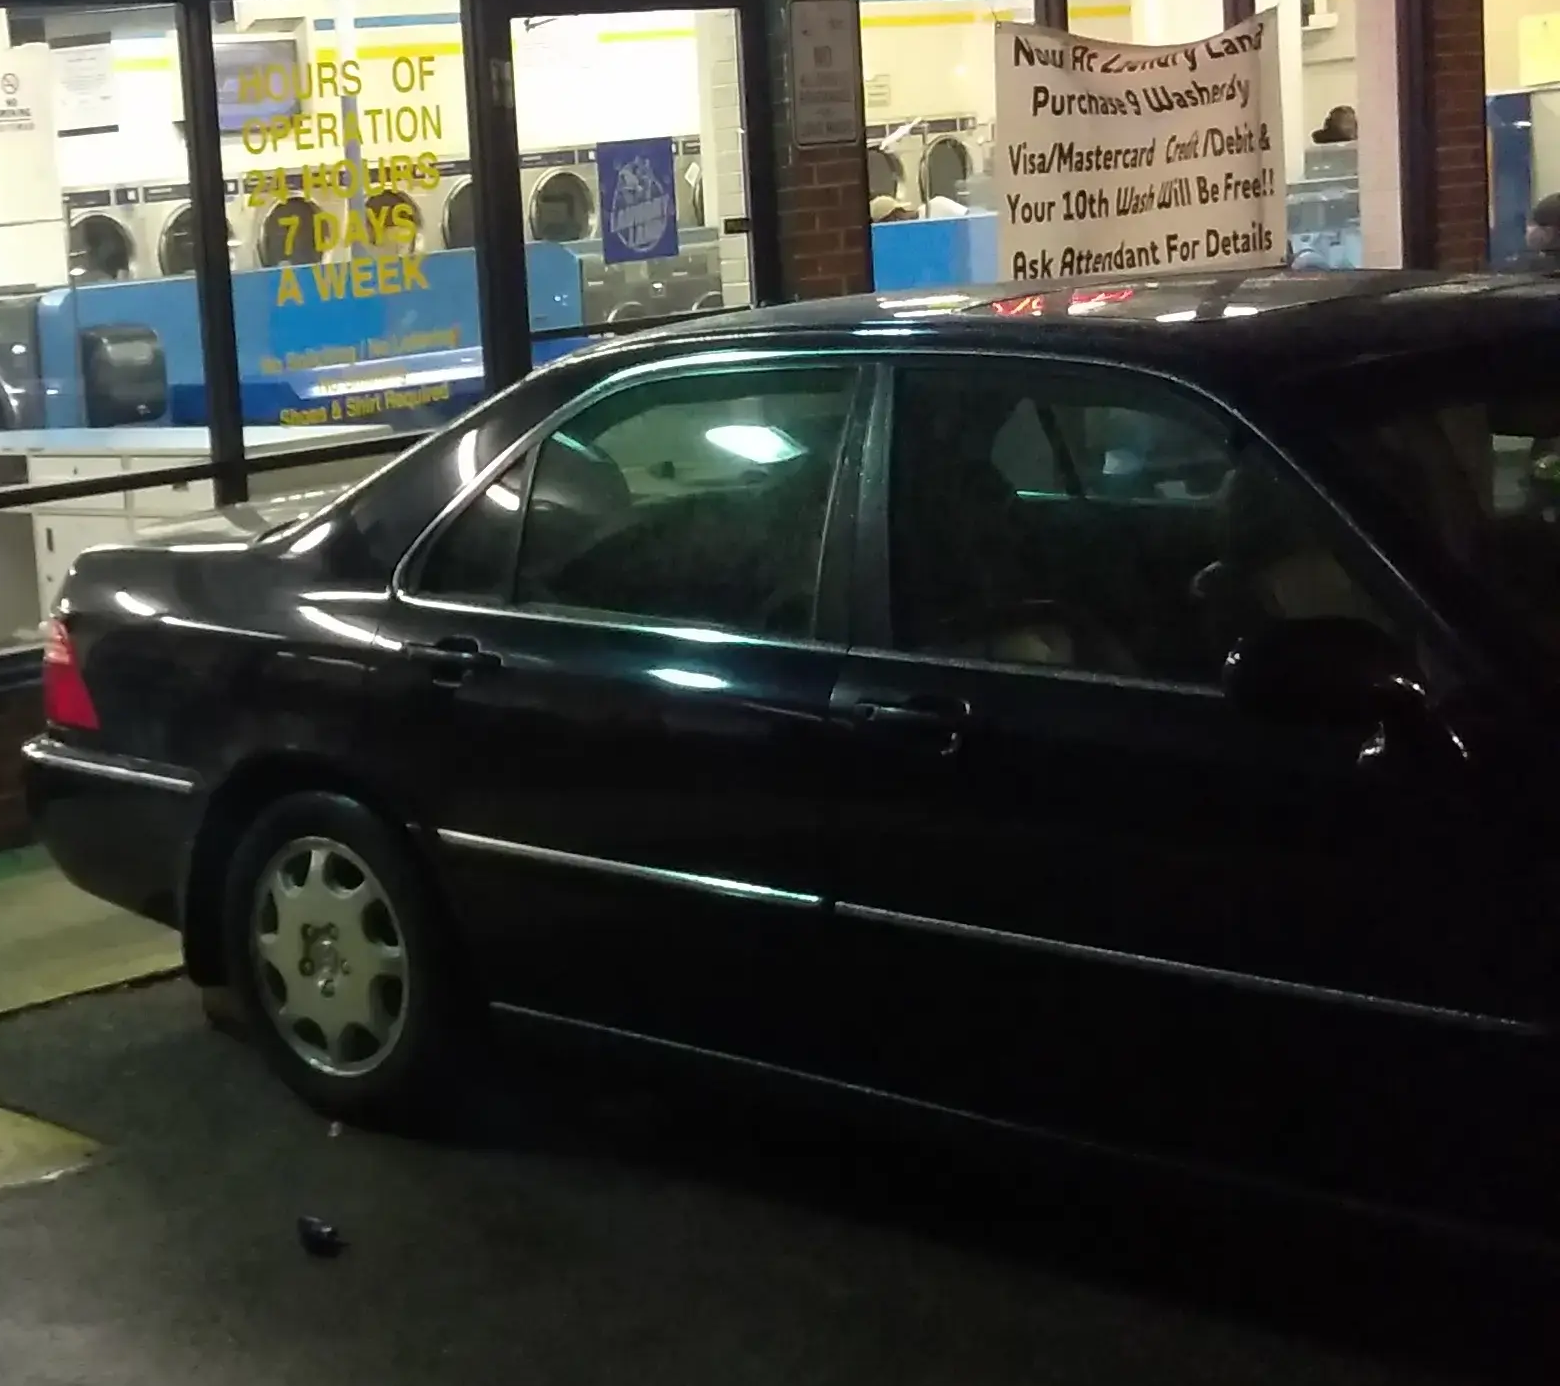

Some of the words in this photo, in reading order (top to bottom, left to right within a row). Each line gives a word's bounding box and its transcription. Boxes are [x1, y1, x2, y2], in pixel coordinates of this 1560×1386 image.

[1204, 22, 1265, 59] Land
[237, 59, 363, 104] HOURS
[392, 55, 436, 94] OF
[1032, 85, 1128, 117] Purchase
[242, 104, 442, 155] OPERATION
[1008, 137, 1156, 176] Visa/Mastercard
[1259, 122, 1271, 151] &
[246, 167, 289, 207] 24
[301, 151, 441, 202] HOURS
[1006, 193, 1056, 224] Your
[1061, 189, 1109, 222] 10th
[1115, 184, 1155, 217] Wash
[1156, 177, 1192, 210] Will
[1196, 175, 1220, 206] Be
[1223, 166, 1276, 201] Free!!
[278, 215, 300, 256] 7
[312, 202, 419, 253] DAYS
[1013, 249, 1055, 281] Ask
[1059, 239, 1161, 277] Attendant
[1165, 233, 1200, 263] For
[1205, 220, 1273, 258] Details
[276, 266, 305, 307] A
[311, 253, 430, 302] WEEK
[346, 393, 382, 417] Shirt
